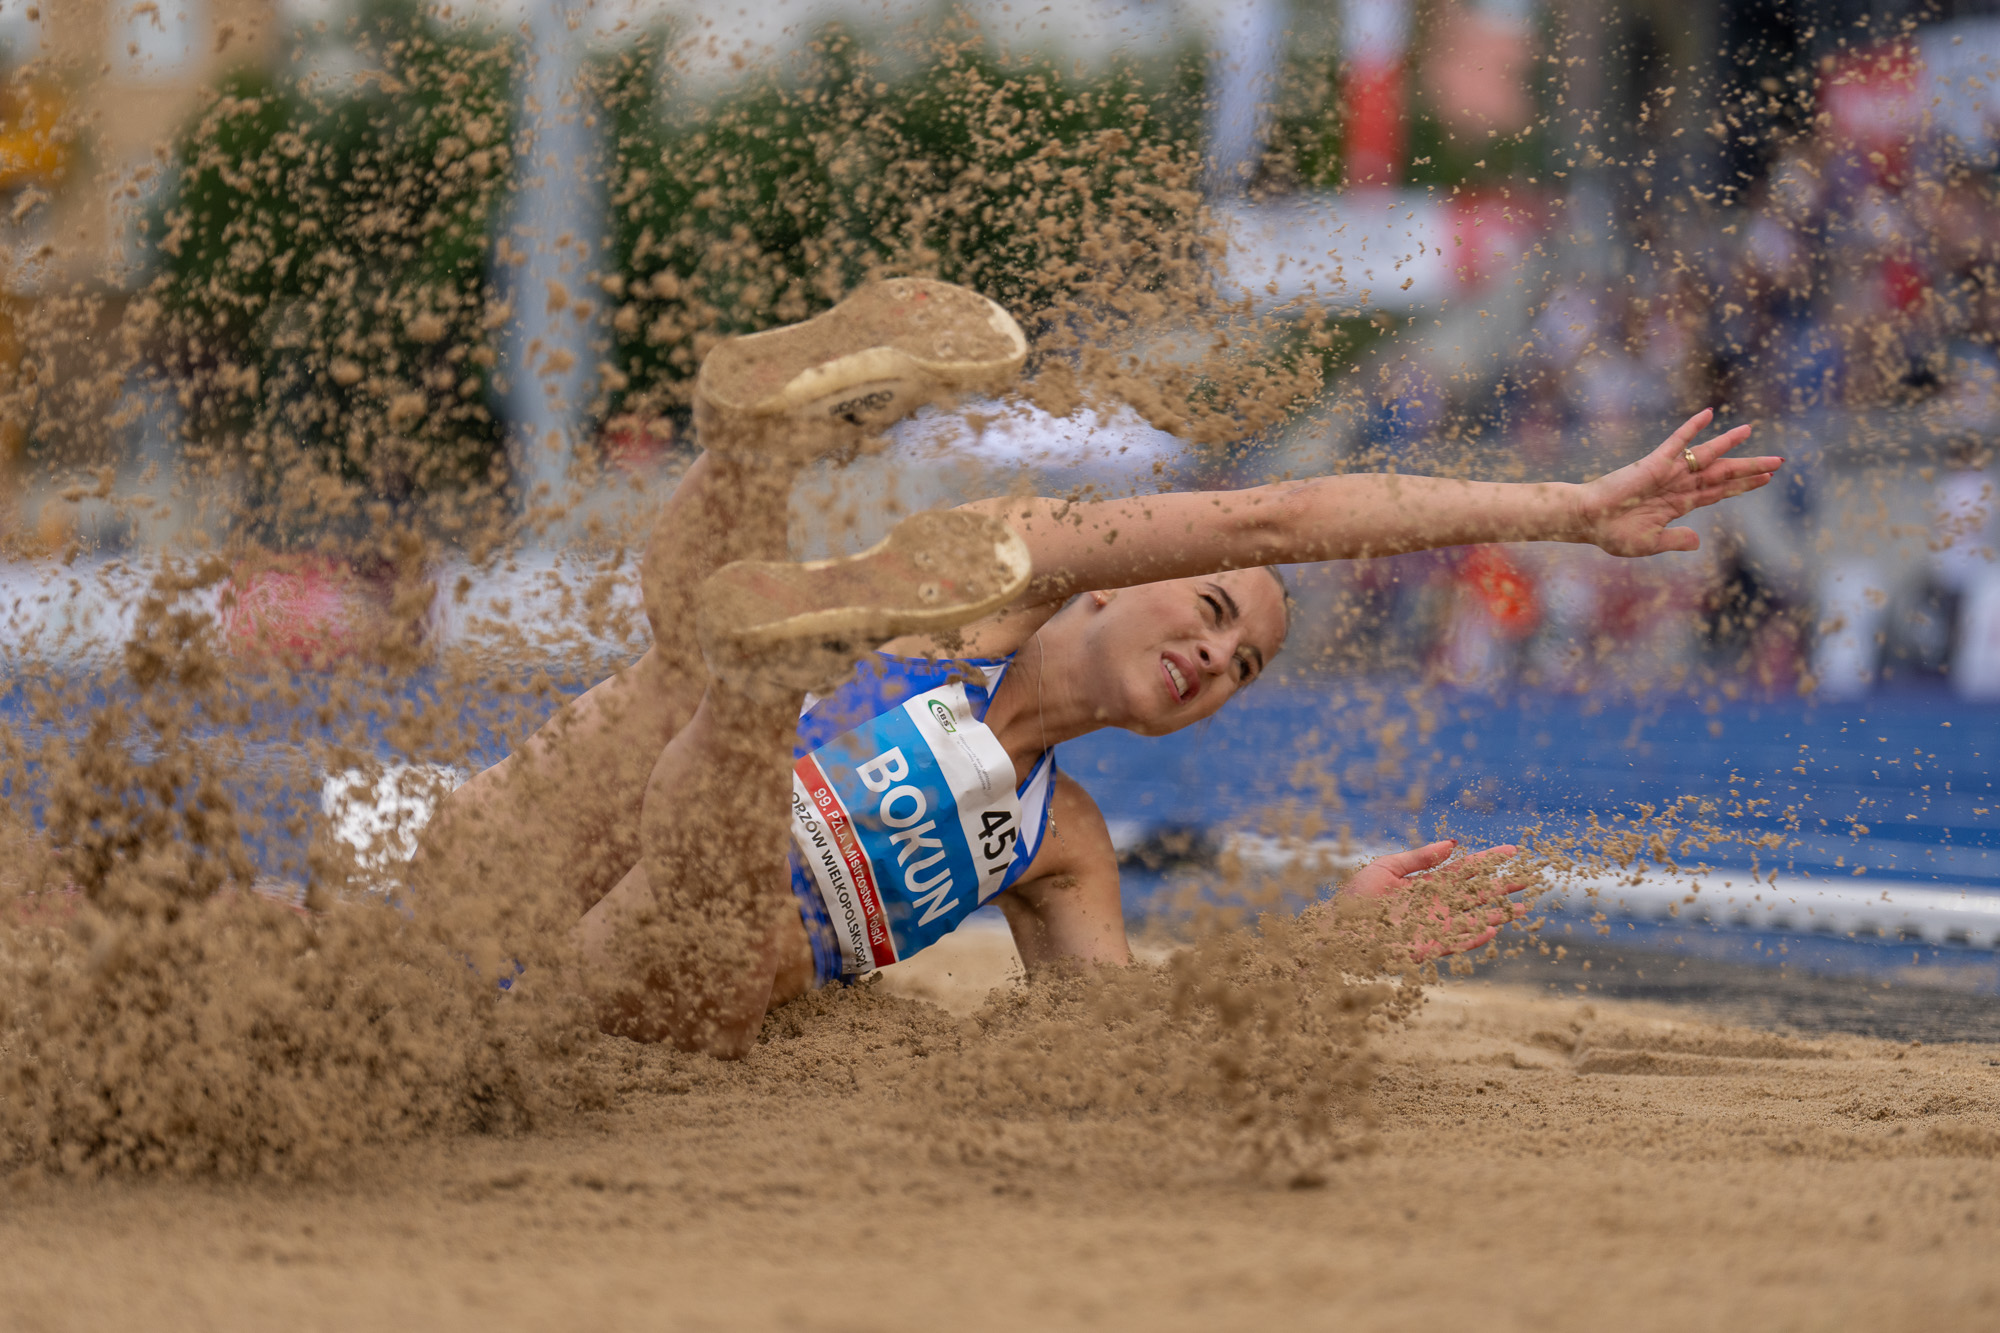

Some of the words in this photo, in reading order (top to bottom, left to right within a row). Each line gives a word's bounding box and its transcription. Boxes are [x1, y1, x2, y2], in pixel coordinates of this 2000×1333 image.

[813, 787, 832, 812] 99.
[826, 809, 848, 844] PZLA
[842, 841, 877, 916] Mistrzostwa
[869, 912, 886, 946] Polski
[821, 848, 862, 946] WIELKOPOLSKI
[855, 745, 960, 928] BOKUN
